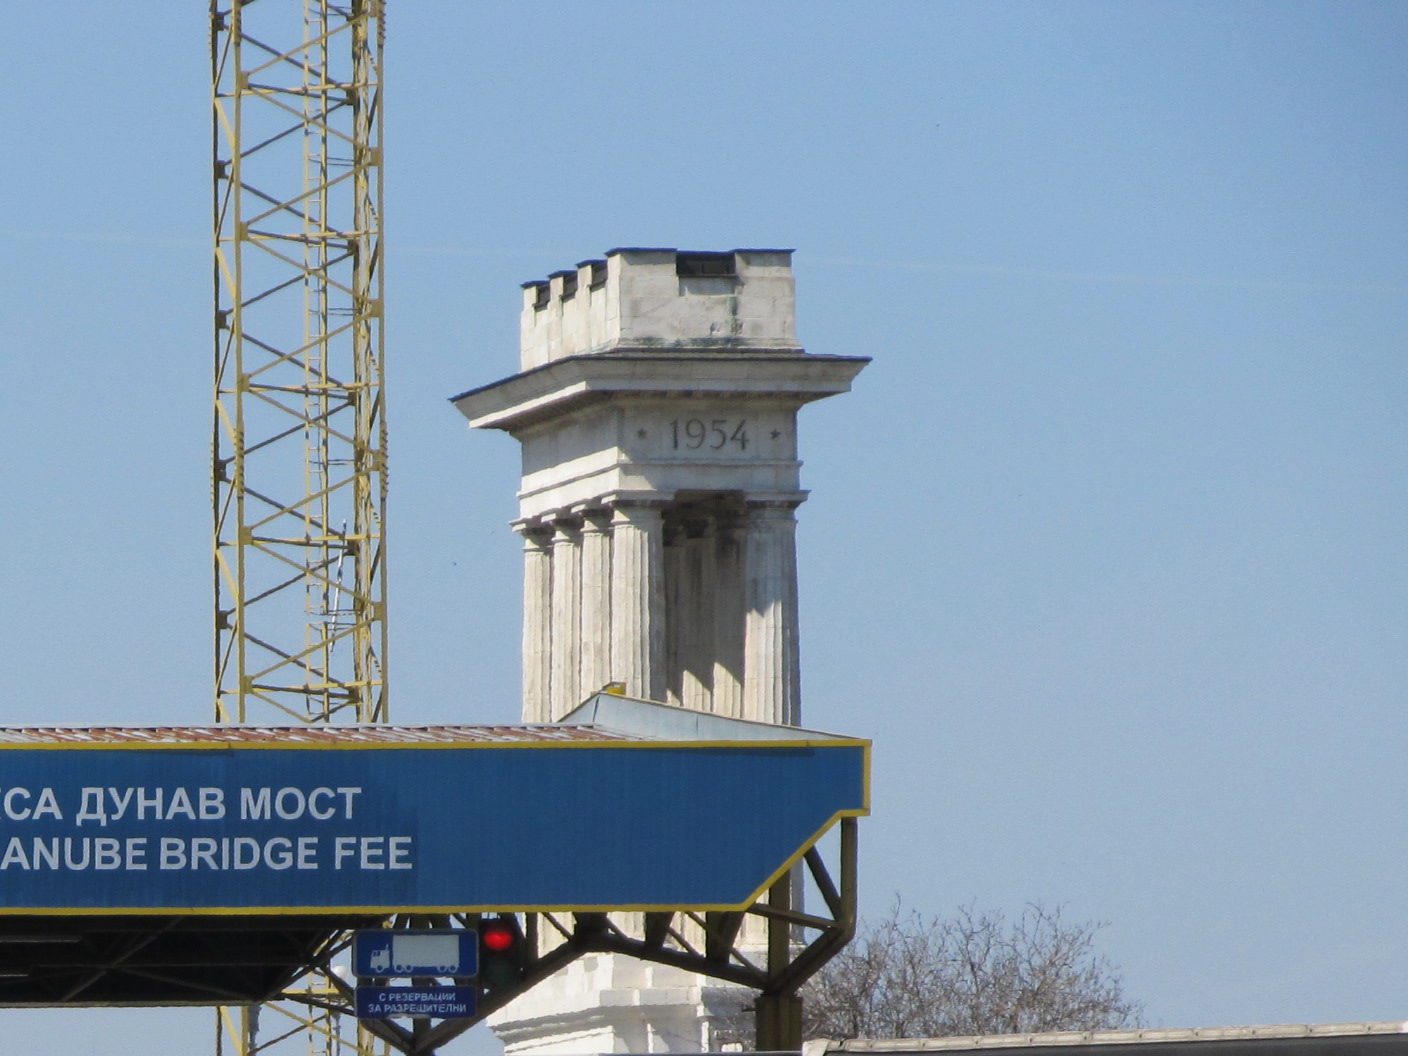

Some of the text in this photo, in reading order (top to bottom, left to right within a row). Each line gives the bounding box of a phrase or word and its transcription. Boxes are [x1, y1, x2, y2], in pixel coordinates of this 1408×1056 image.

[670, 418, 750, 450] 1954
[75, 787, 226, 827] ДУНАВ
[239, 787, 362, 820] МОСТ
[159, 837, 319, 870] BRIDGE
[334, 836, 413, 870] FEE
[368, 1004, 467, 1013] ЗА РАЗРЕШИТЕЛНИ
[389, 993, 456, 1003] РЕЗЕРВАЦИИ
